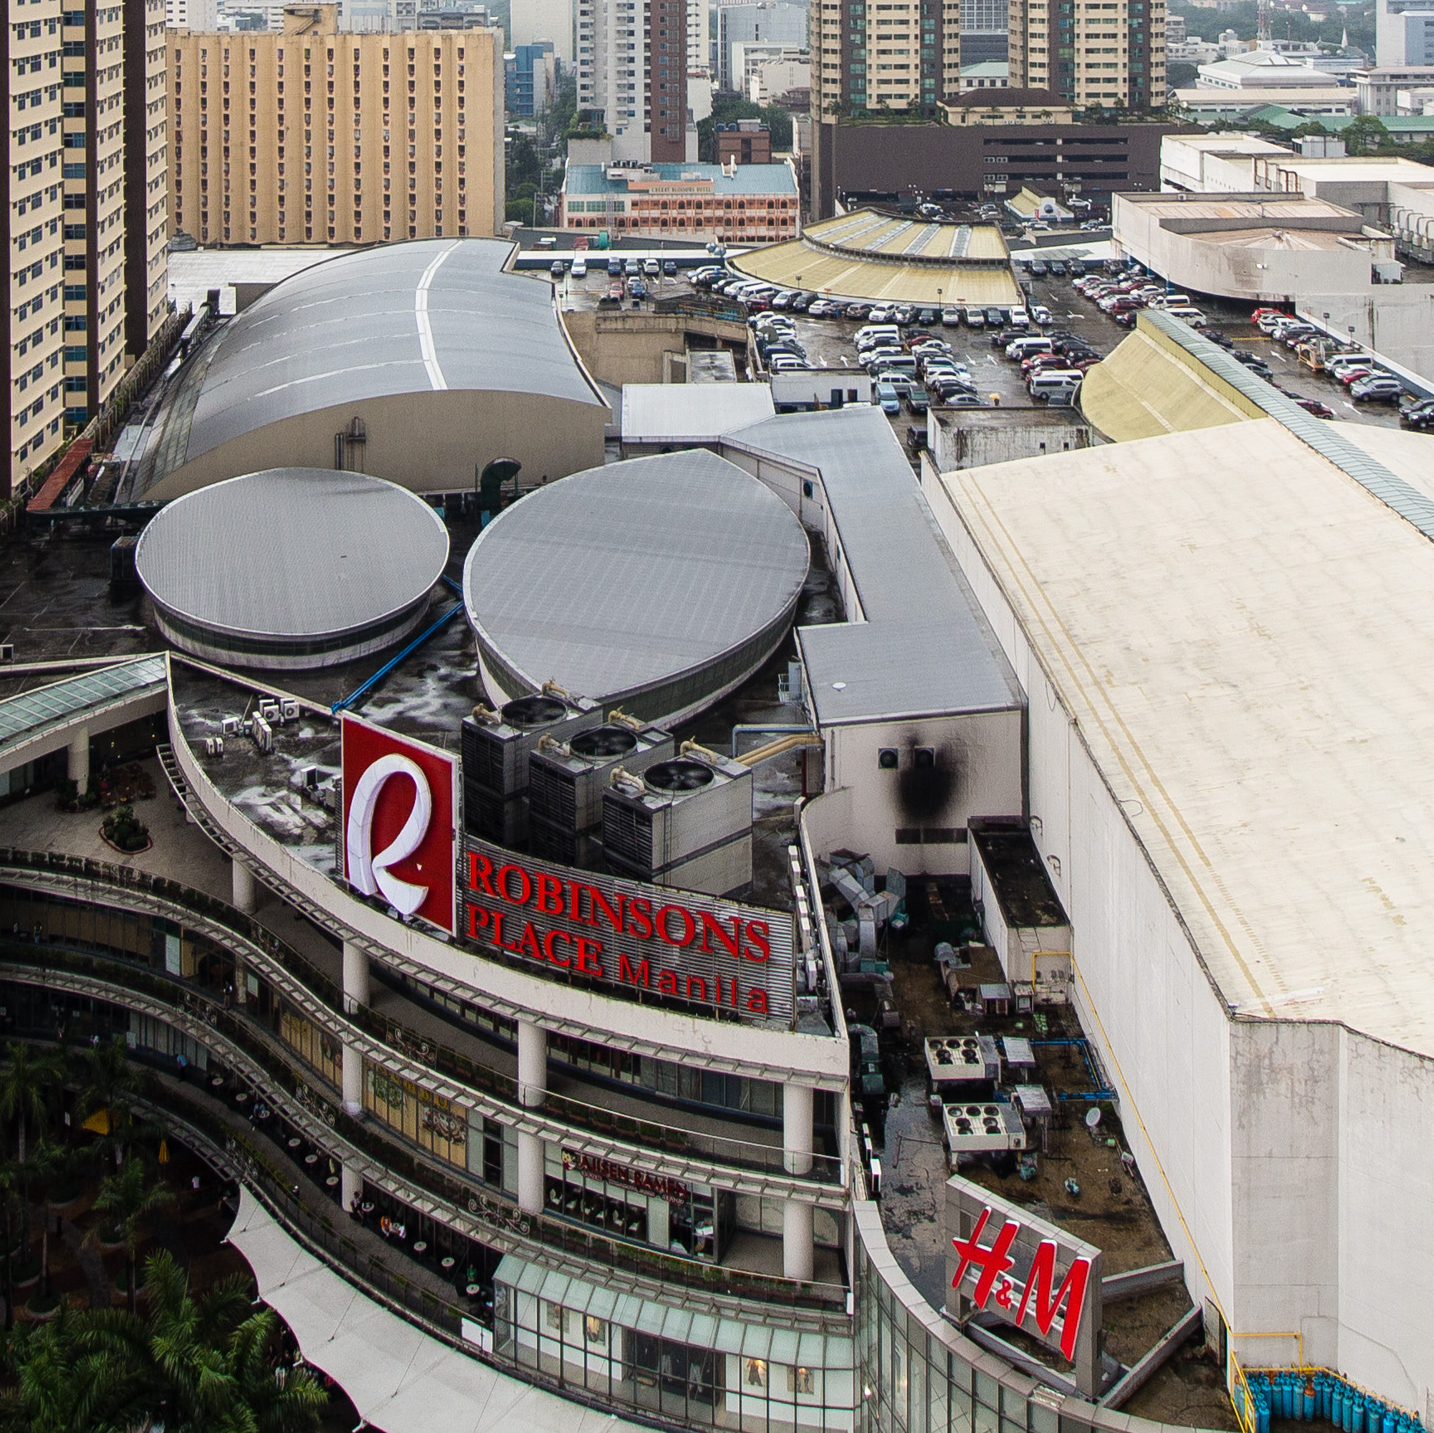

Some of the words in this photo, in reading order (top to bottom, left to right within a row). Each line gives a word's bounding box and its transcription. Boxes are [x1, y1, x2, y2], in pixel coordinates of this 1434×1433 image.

[465, 903, 604, 979] PLACE
[617, 953, 769, 1015] Manila
[466, 851, 771, 964] ROBINSONS
[633, 1169, 687, 1198] RAMEN
[952, 1206, 1092, 1362] H&M
